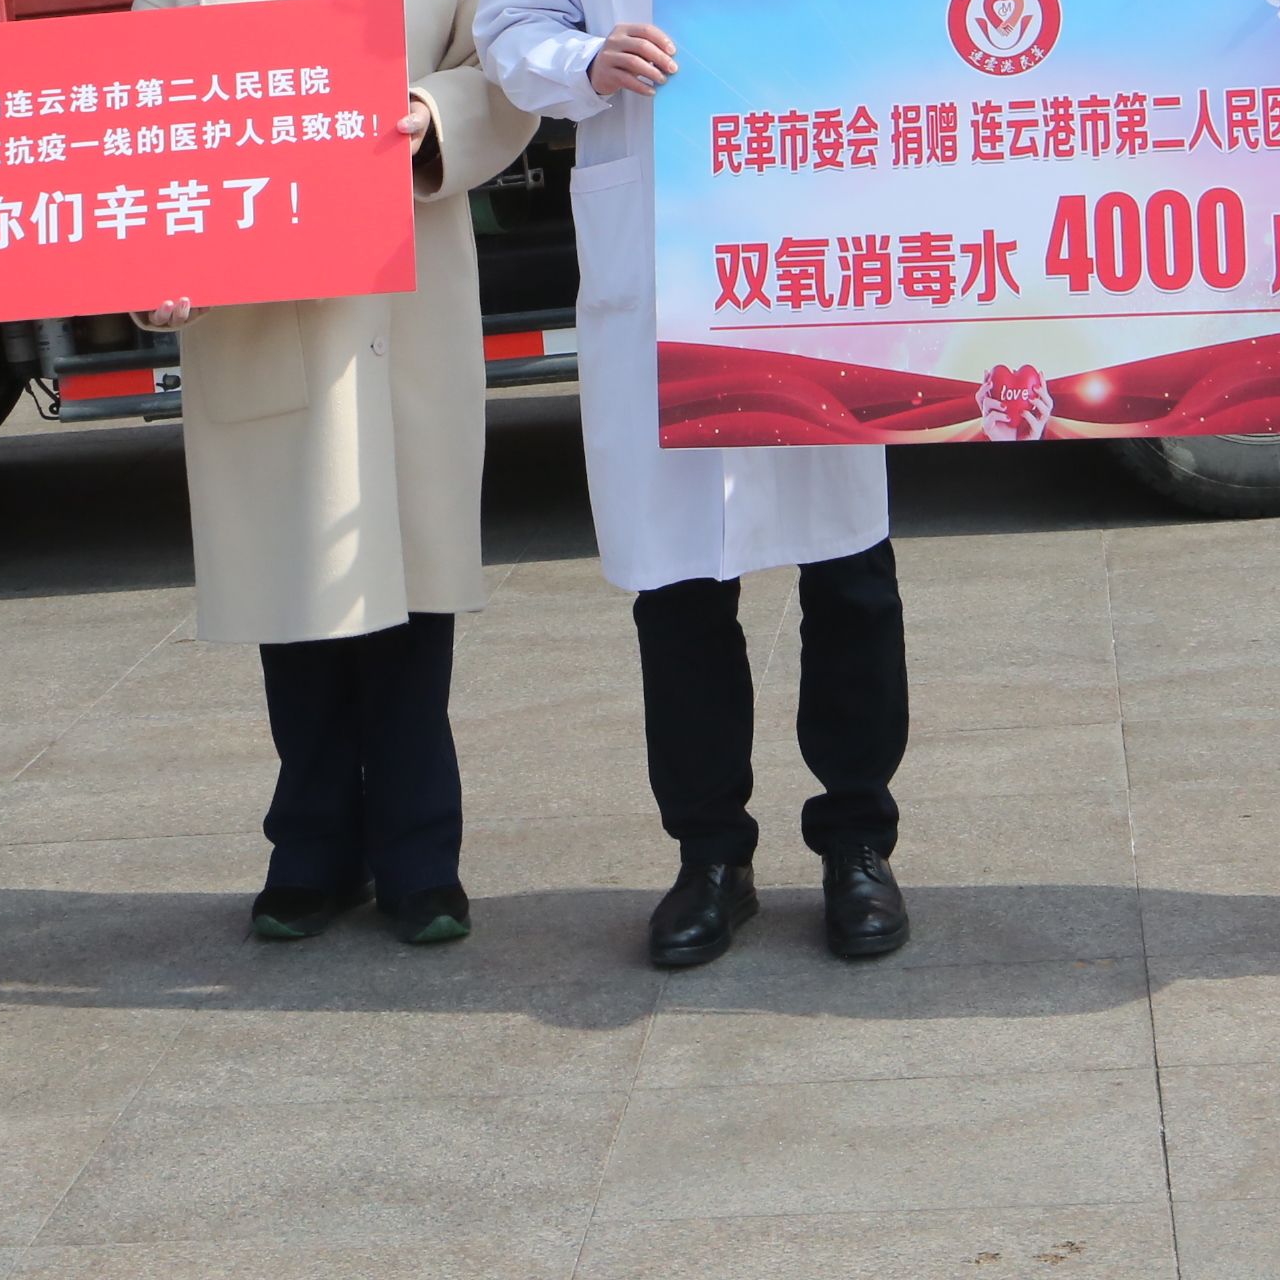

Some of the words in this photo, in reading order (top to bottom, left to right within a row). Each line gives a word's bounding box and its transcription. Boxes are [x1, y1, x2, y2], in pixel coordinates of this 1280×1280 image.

[712, 106, 879, 175] 民革市委会
[891, 102, 959, 167] 捐赠
[714, 228, 1021, 311] 双氧消毒水
[1045, 187, 1247, 293] 4000
[1000, 384, 1029, 401] love
